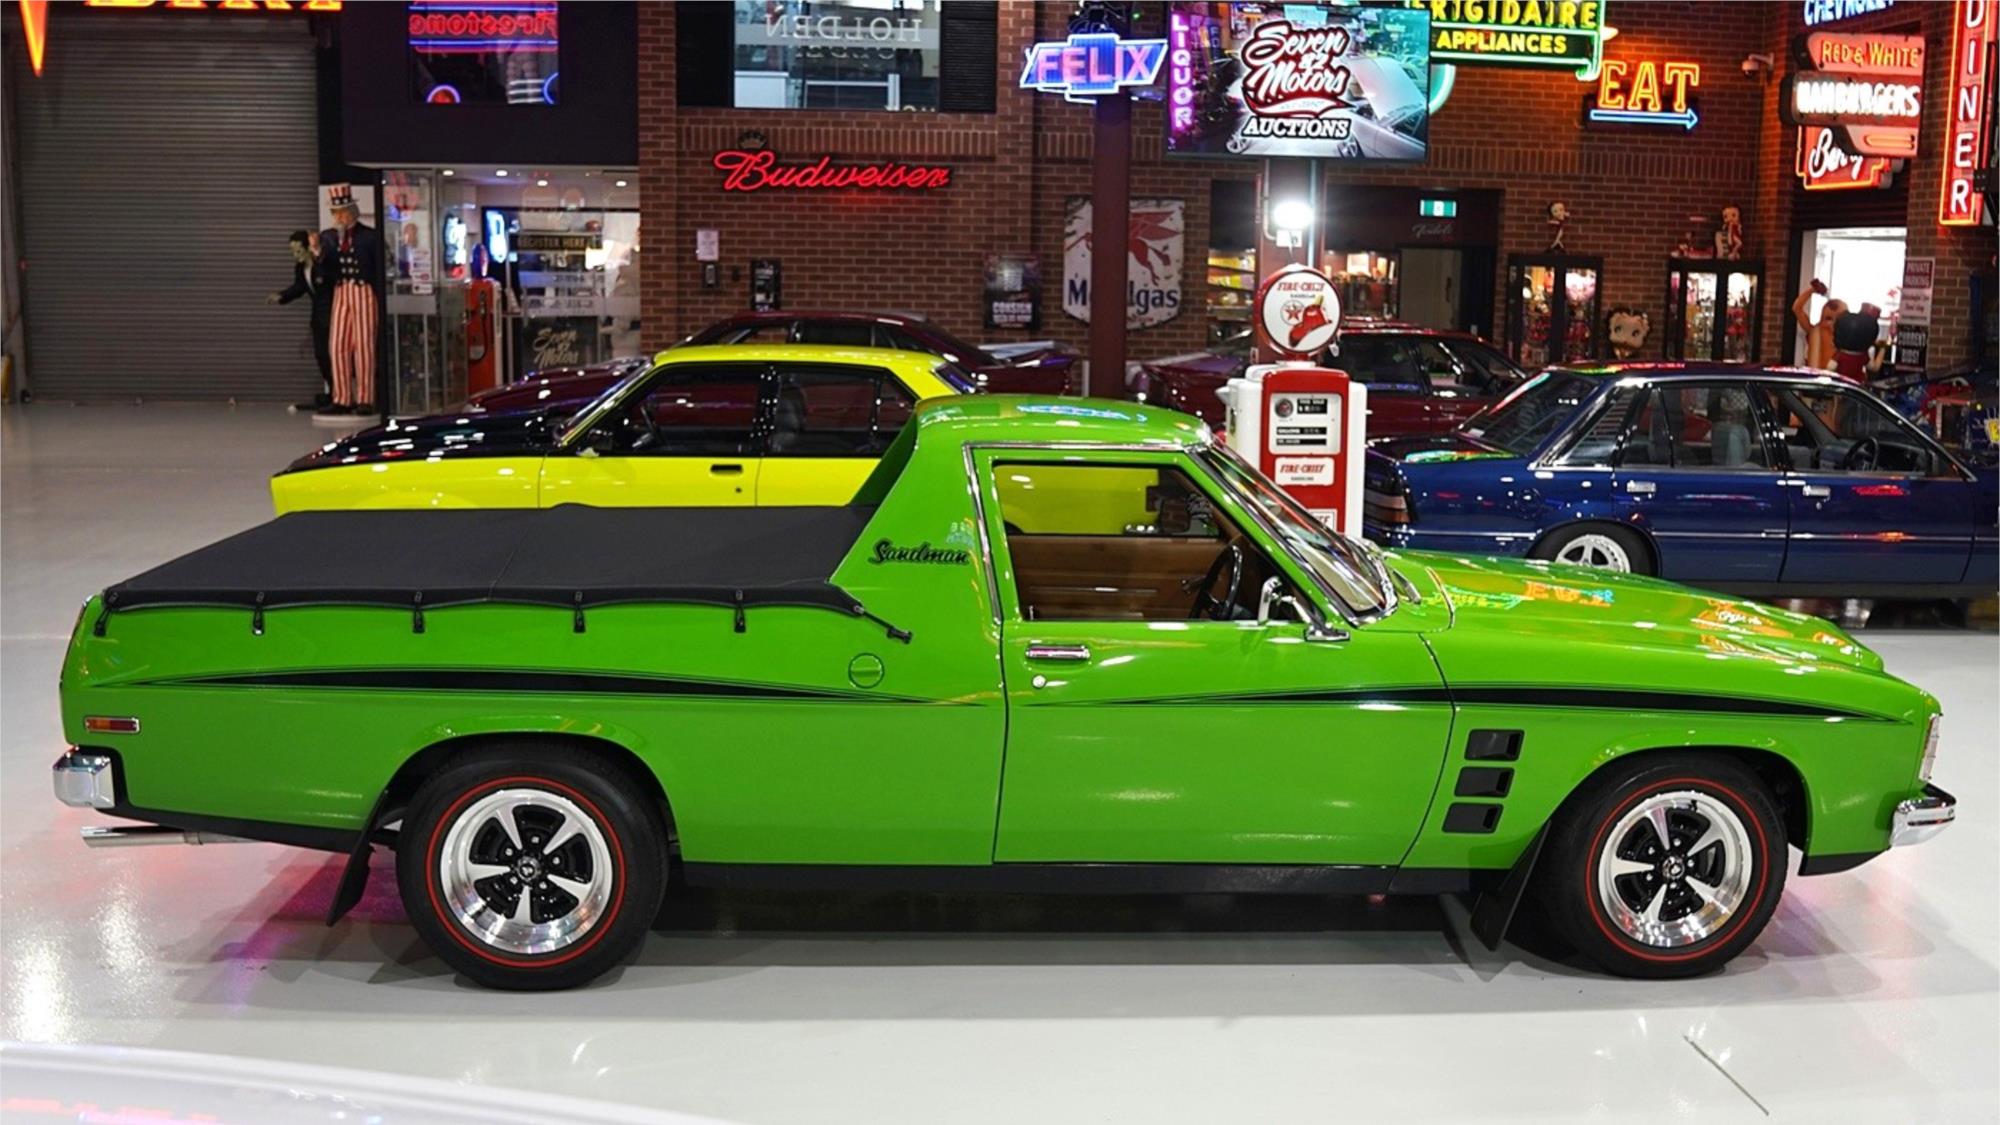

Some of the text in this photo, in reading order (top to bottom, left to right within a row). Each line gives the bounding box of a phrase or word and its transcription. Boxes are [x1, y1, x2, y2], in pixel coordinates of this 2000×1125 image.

[1412, 0, 1597, 29] RIGIDAIRE
[1804, 0, 1893, 26] CHEVRO
[1244, 24, 1344, 66] Seven
[1436, 30, 1567, 54] APPLIANCES
[1037, 46, 1152, 83] FELIX
[1171, 14, 1193, 128] LIQUOR
[1246, 60, 1347, 101] Motors
[1599, 61, 1699, 113] EAT
[1951, 0, 1985, 214] DINER
[1242, 117, 1350, 139] AUCTIONS
[714, 150, 949, 190] Budweiser
[1068, 279, 1179, 315] Mlgas
[867, 539, 970, 564] Sandman
